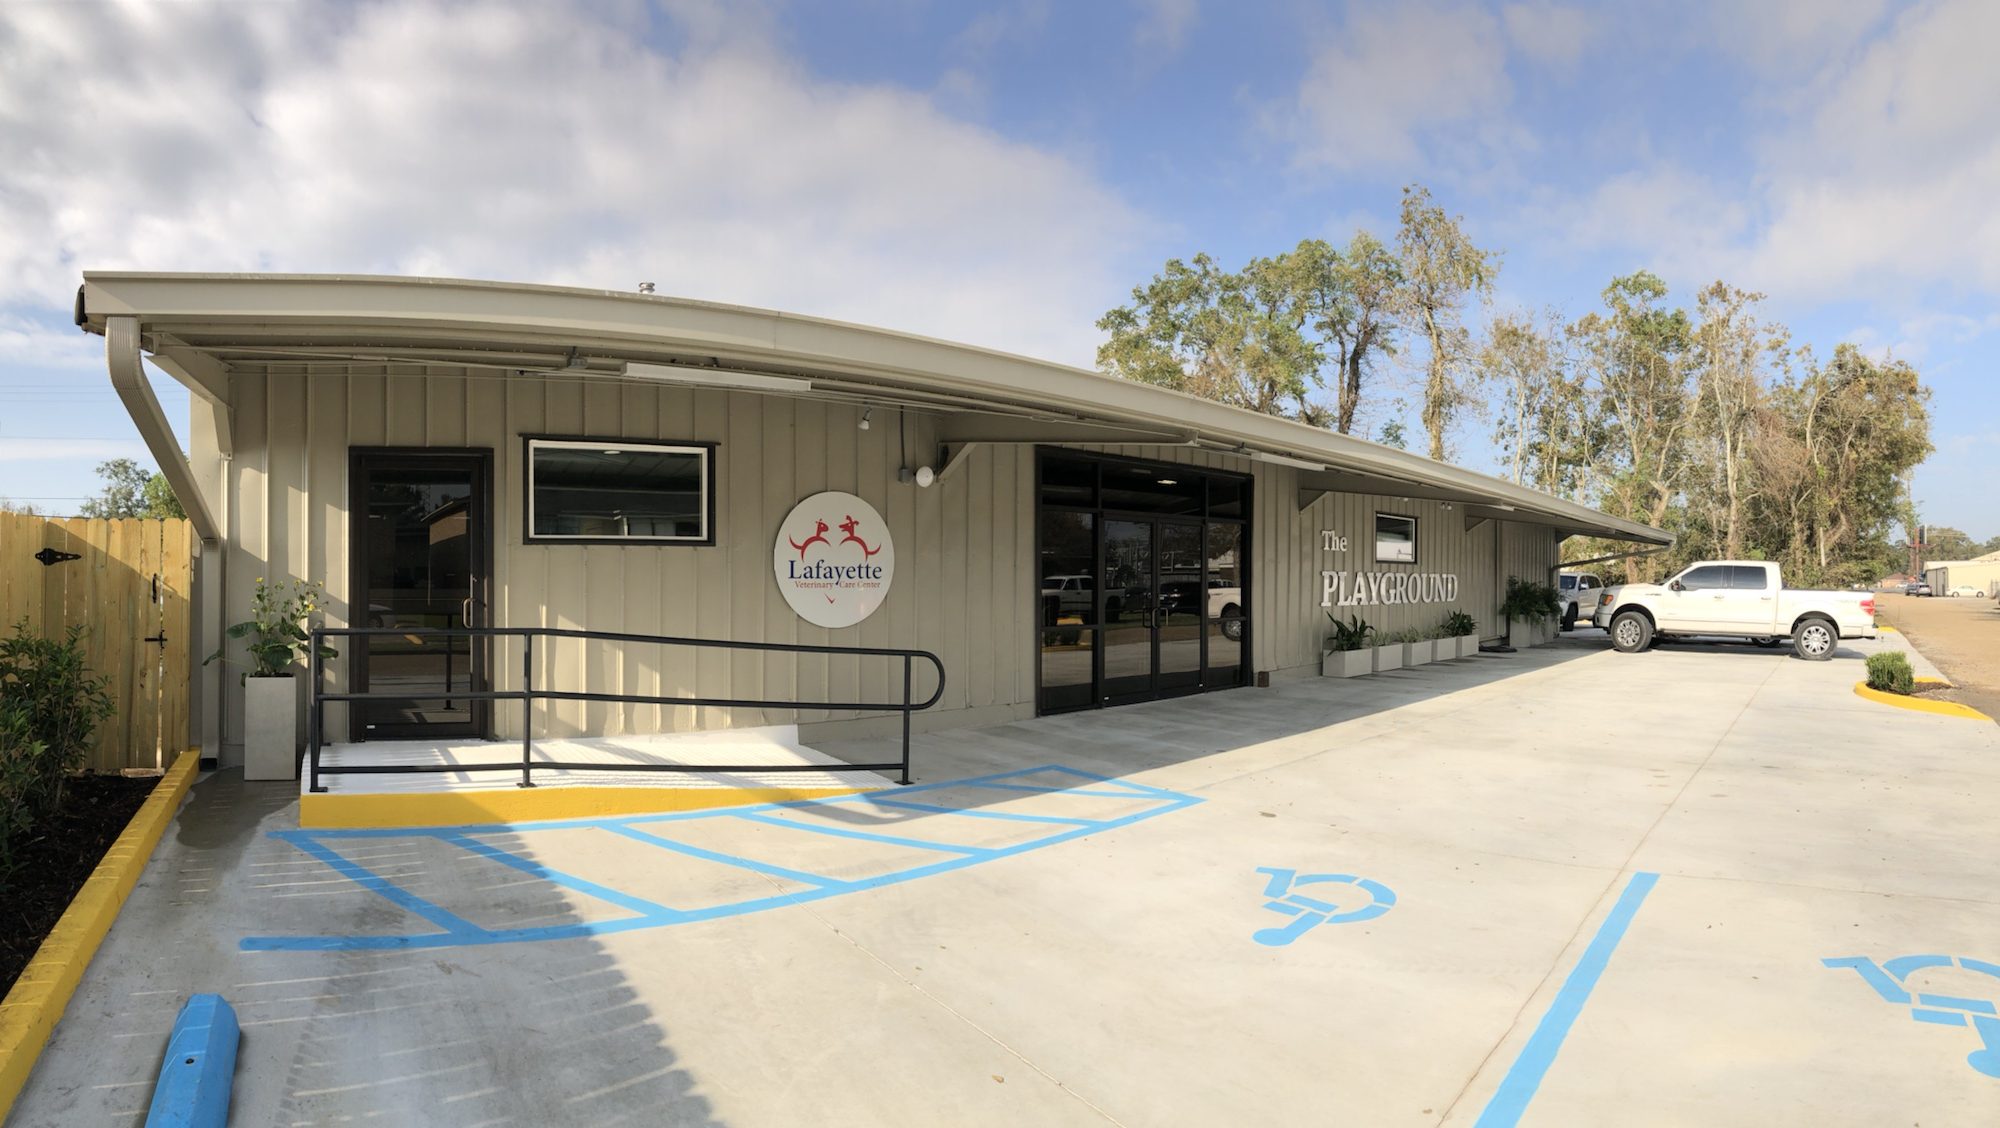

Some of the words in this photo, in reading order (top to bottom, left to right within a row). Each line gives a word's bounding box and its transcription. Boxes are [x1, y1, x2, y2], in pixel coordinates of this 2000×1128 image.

[1321, 530, 1348, 552] The
[788, 559, 882, 586] Lafayette
[795, 580, 833, 589] Veterinary
[839, 580, 856, 588] Care
[857, 580, 881, 588] Center
[1320, 570, 1458, 607] PLAYGROUND
